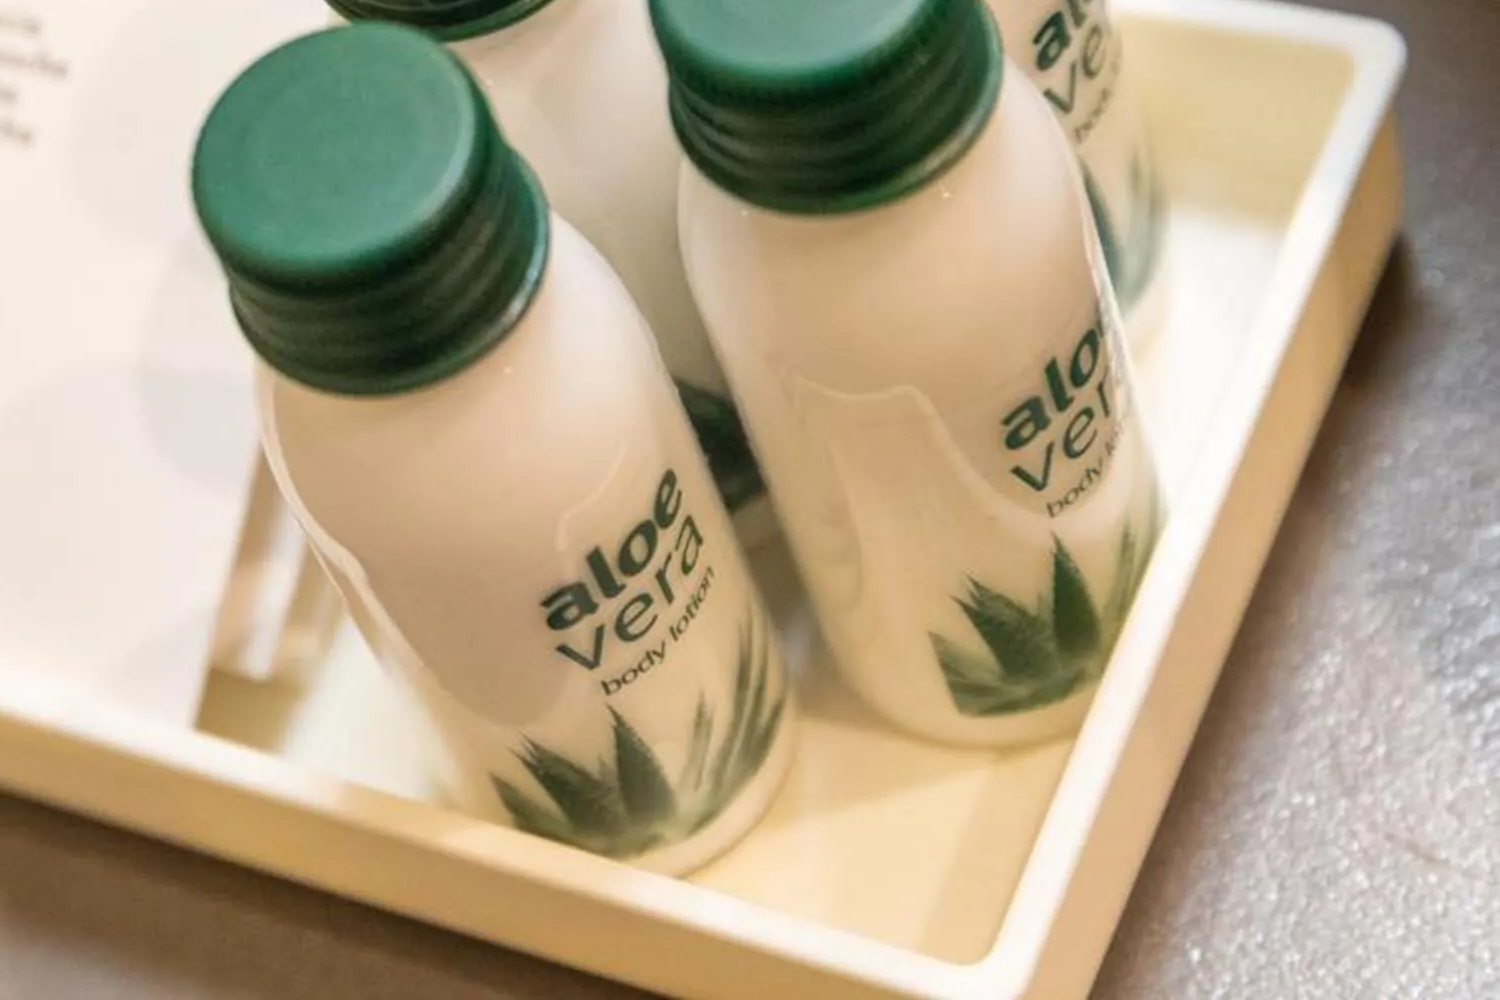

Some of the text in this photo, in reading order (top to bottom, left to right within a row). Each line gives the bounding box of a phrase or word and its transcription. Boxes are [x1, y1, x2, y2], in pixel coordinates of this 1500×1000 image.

[1043, 24, 1105, 114] ve
[1000, 319, 1105, 450] alo
[1009, 366, 1112, 491] ver
[539, 468, 682, 631] aloe
[555, 514, 703, 671] vera
[600, 565, 716, 697] body lotion
